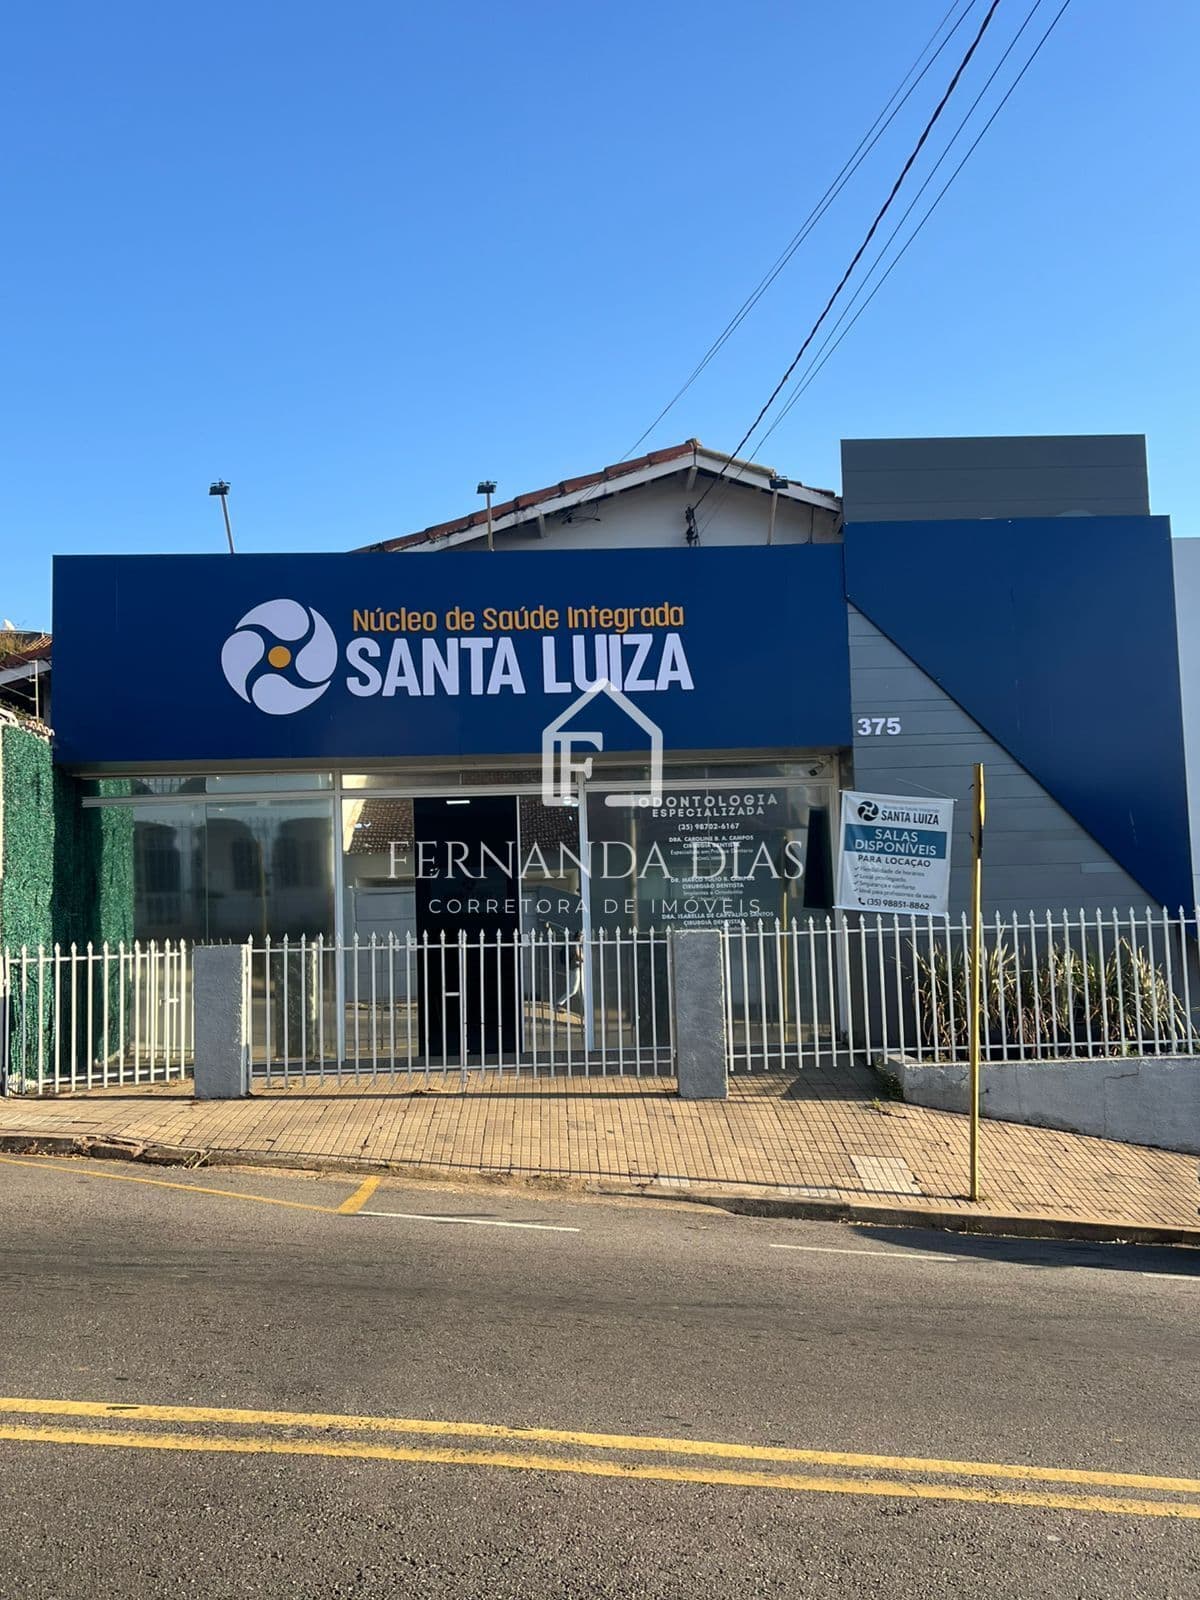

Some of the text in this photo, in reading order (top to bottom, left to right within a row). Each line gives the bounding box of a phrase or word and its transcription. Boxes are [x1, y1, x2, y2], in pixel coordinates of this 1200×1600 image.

[353, 602, 684, 633] Núcleo de Saúde Integrada
[346, 632, 695, 697] SANTA LUIZA
[857, 717, 901, 736] 375
[639, 794, 778, 808] ODONTOLOGIA
[652, 806, 765, 818] ESPECIALIZADA
[881, 810, 939, 825] SANTA LUIZA
[875, 828, 918, 843] SALAS
[855, 839, 936, 856] DISPONÍVEIS
[858, 854, 882, 863] PARA
[867, 898, 881, 907] (35)
